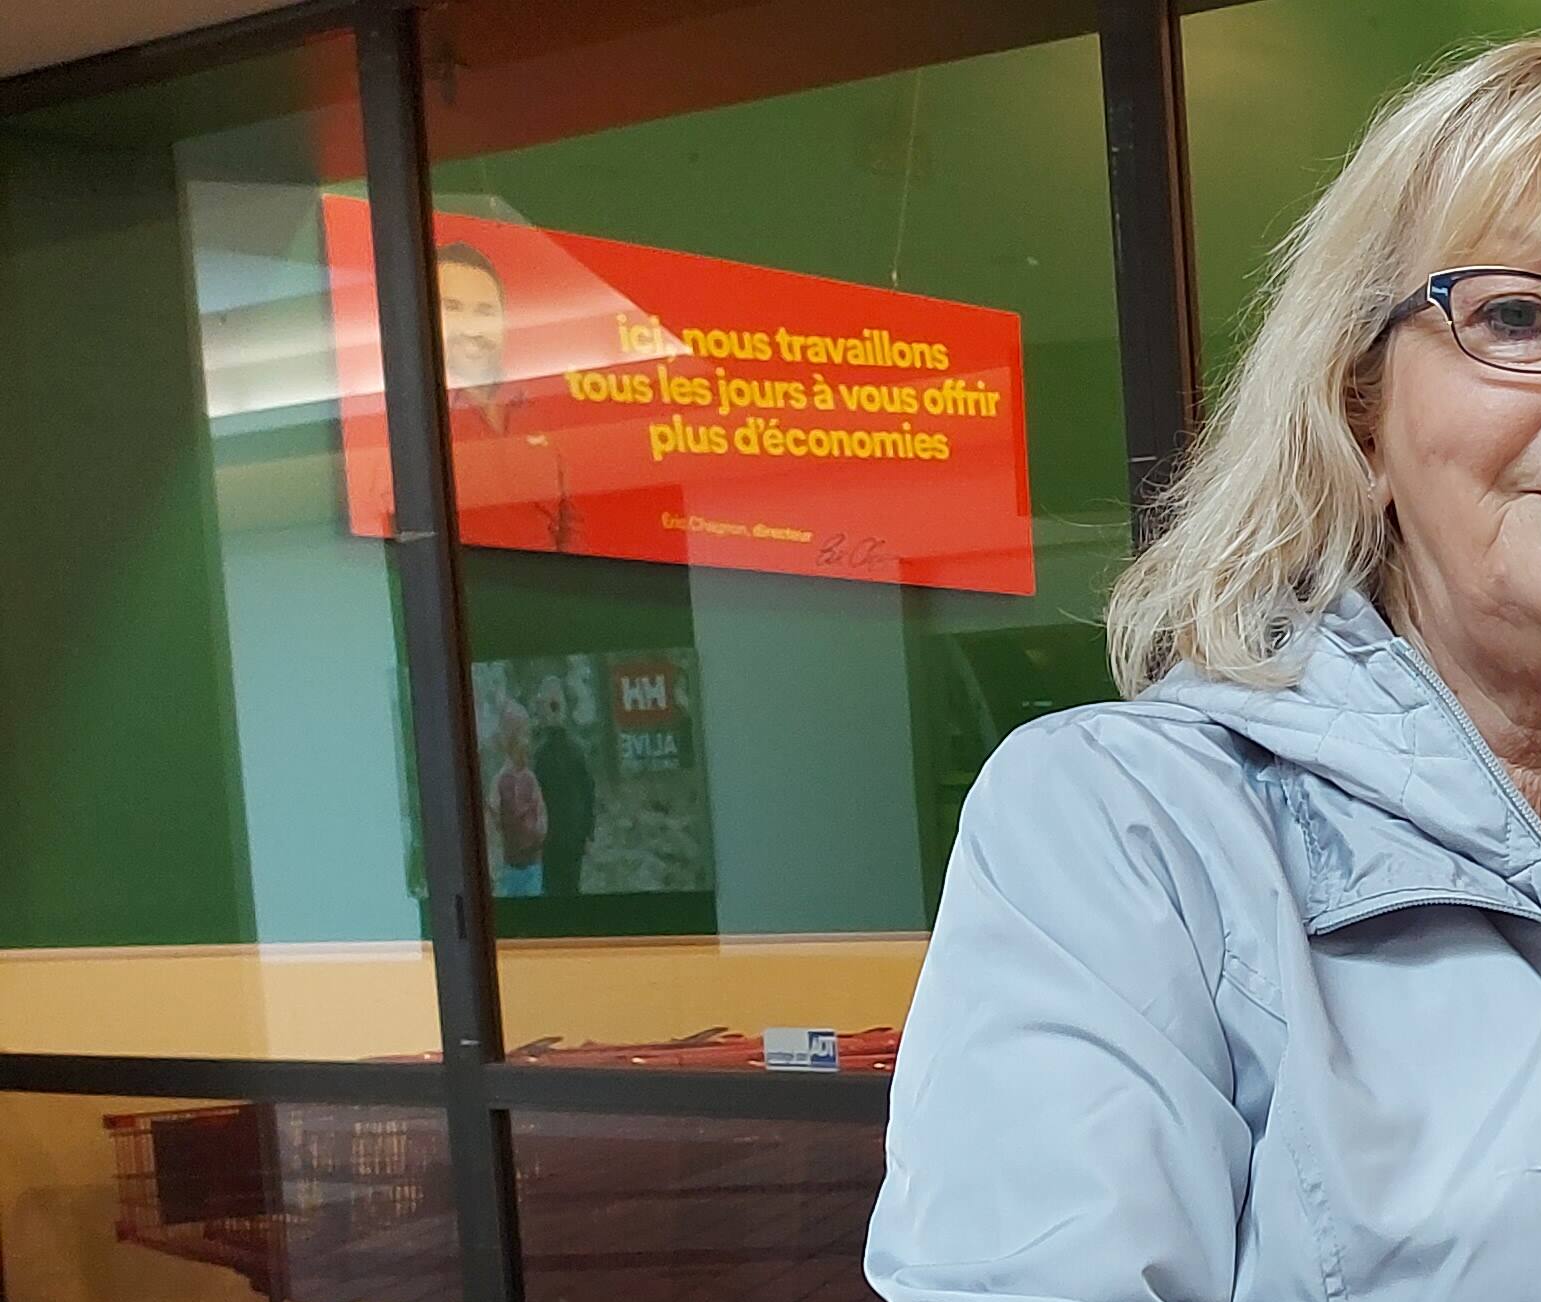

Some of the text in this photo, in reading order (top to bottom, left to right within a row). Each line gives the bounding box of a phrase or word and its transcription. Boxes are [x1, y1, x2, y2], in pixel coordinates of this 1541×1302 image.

[682, 327, 772, 361] nous
[776, 327, 949, 371] travaillons
[564, 363, 1000, 417] tous les jours à vous offrir
[649, 413, 950, 461] plus d'économies
